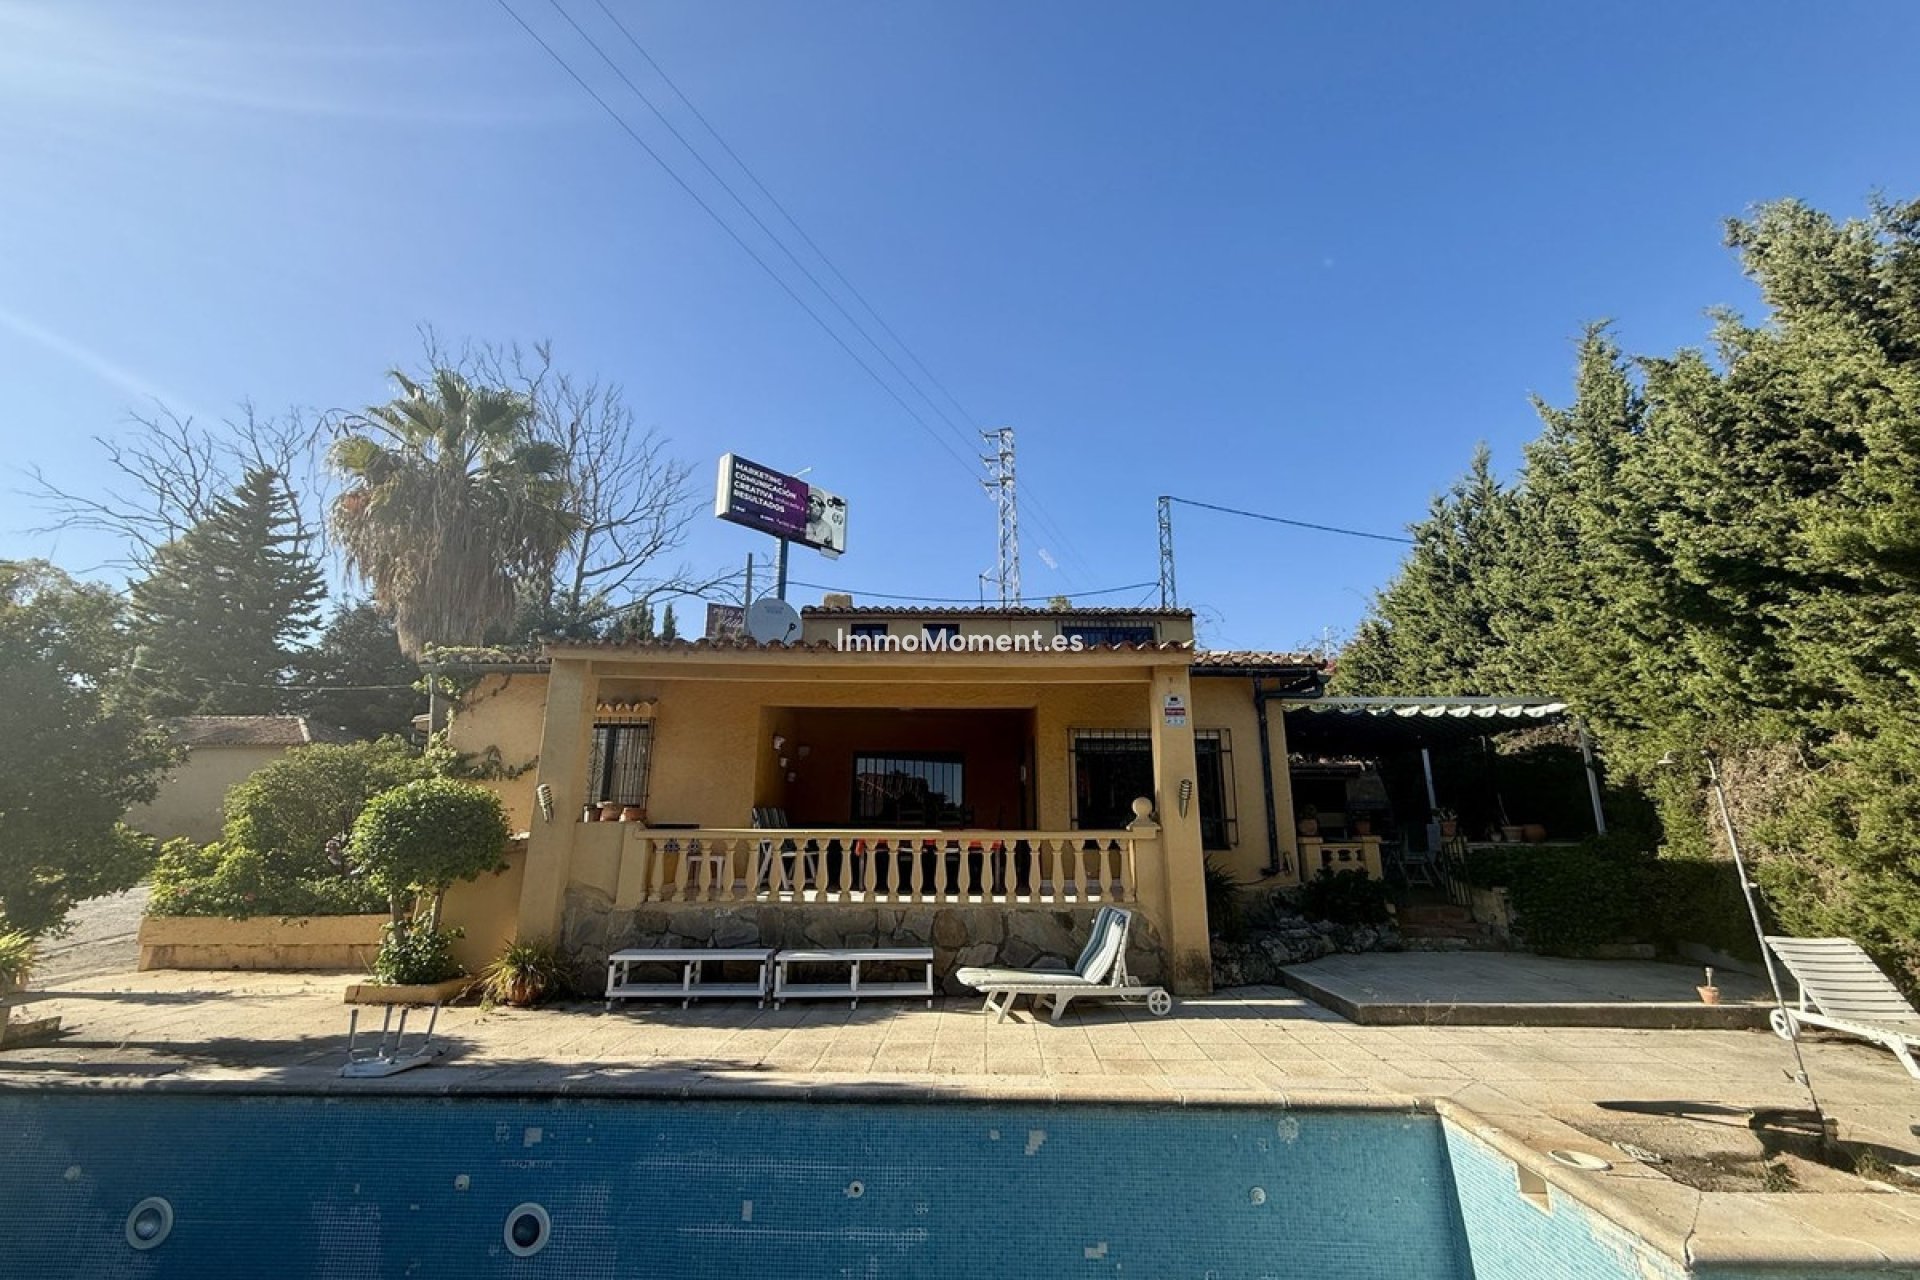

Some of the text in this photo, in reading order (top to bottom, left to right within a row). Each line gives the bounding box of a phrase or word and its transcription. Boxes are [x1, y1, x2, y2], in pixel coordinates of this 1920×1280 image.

[735, 462, 783, 486] MARKETING
[733, 489, 785, 513] RESULTADOS
[734, 481, 774, 500] CREATIVA
